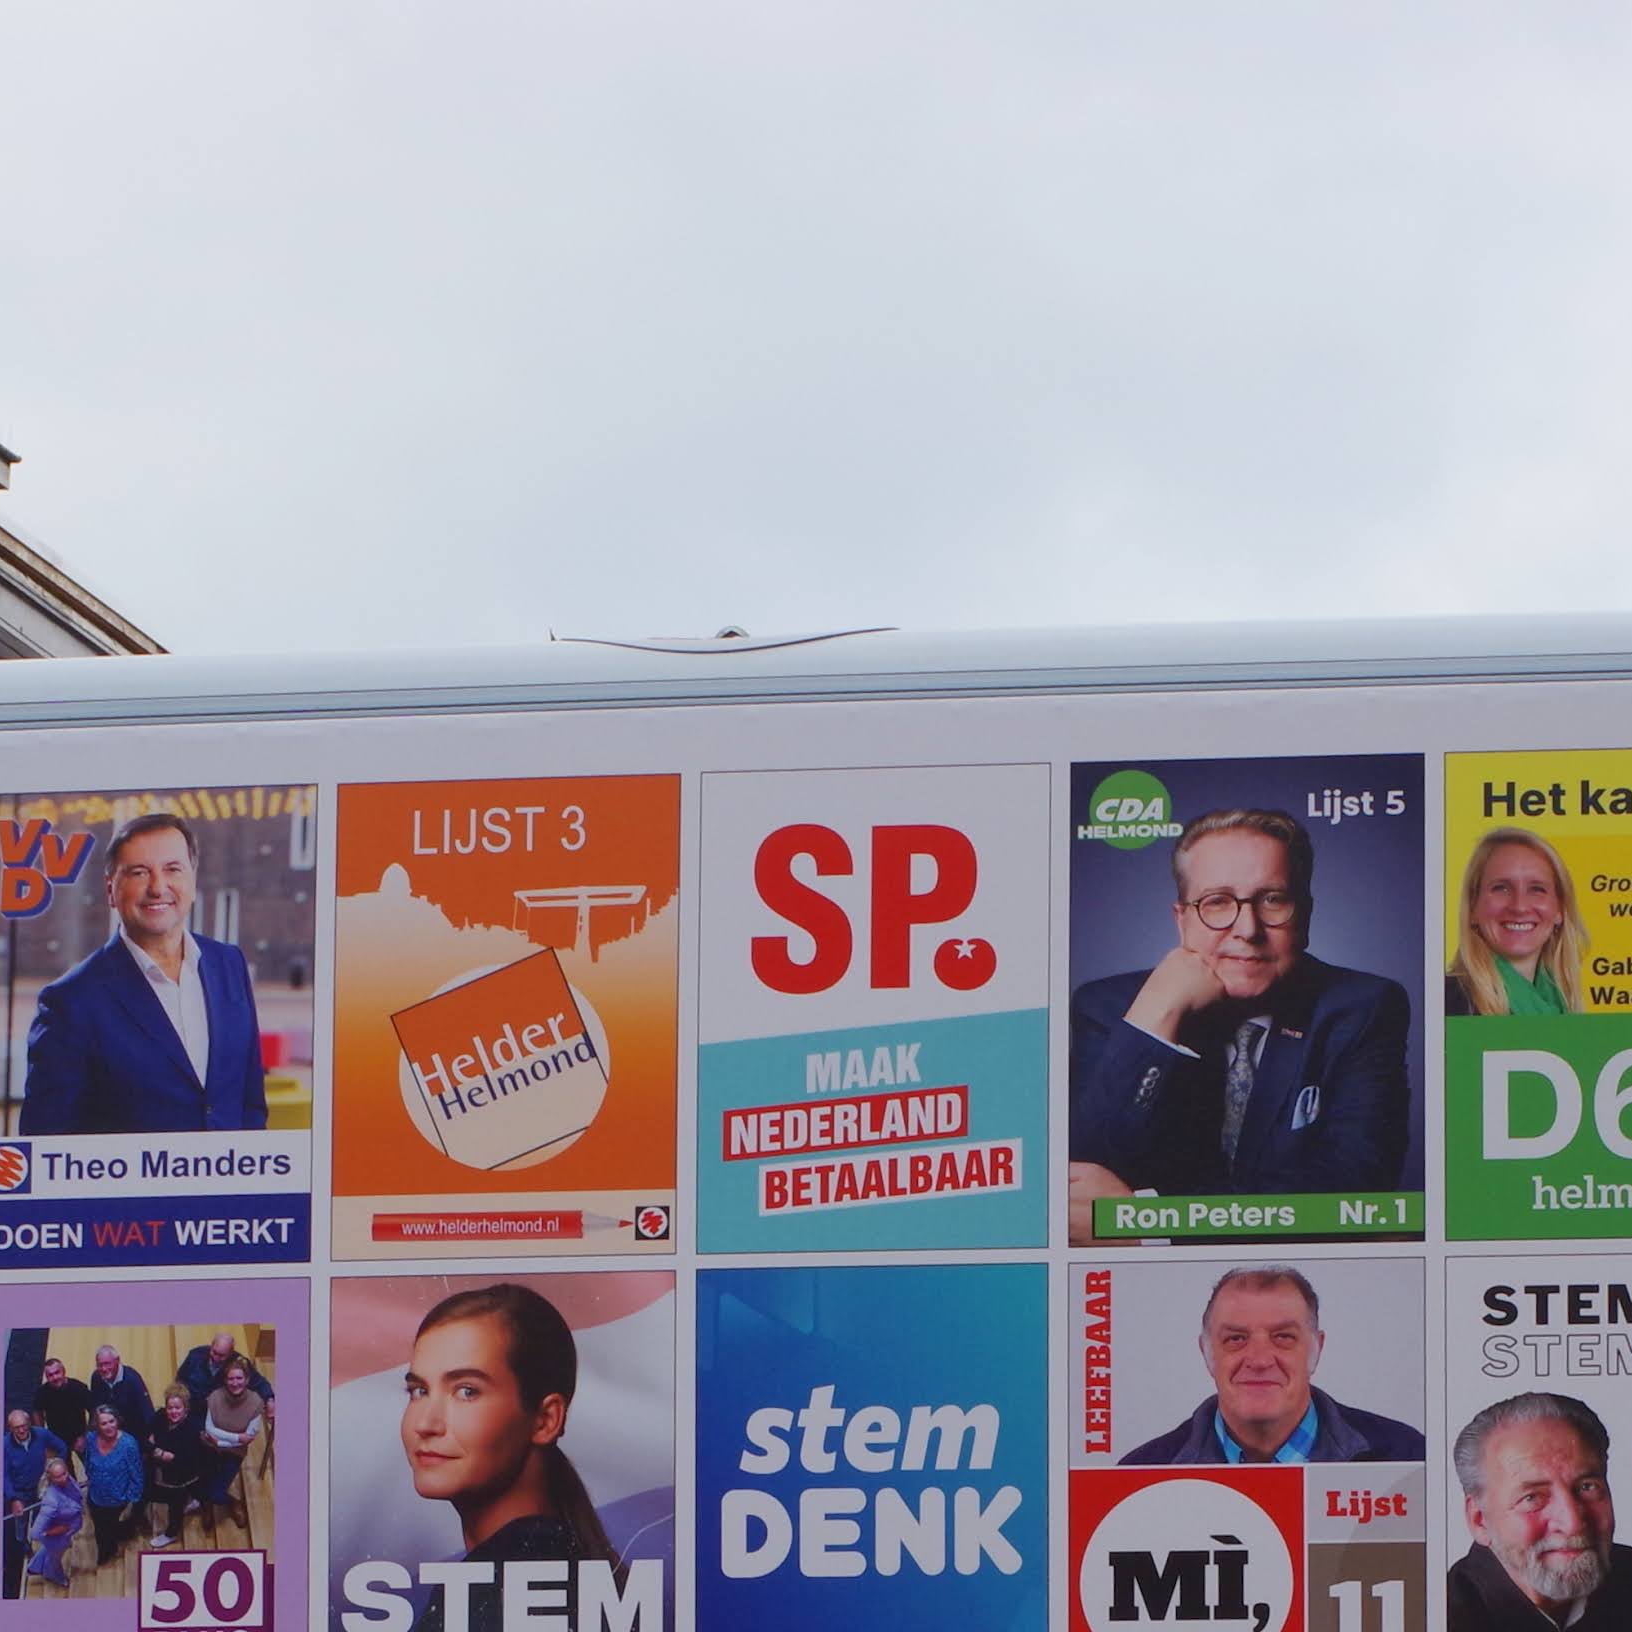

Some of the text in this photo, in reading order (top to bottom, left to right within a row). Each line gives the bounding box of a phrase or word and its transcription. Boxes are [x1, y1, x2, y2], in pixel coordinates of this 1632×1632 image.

[1094, 796, 1165, 822] CDA
[1307, 790, 1406, 825] Lijst 5
[1482, 781, 1565, 817] Het
[412, 805, 588, 855] LIJST 3
[1077, 823, 1183, 840] HELMOND
[410, 1012, 569, 1099] Helder
[436, 1033, 598, 1121] Helmond
[805, 1043, 920, 1094] MAAK
[729, 1091, 963, 1155] NEDERLAND
[40, 1149, 291, 1183] Theo Manders
[765, 1146, 1014, 1210] BETAALBAAR
[94, 1221, 165, 1248] WAT
[175, 1217, 295, 1246] WERKT
[401, 1217, 560, 1237] www.helderhelmond.nl
[1115, 1198, 1407, 1230] Ron Peters Nr. 1
[1085, 1269, 1112, 1454] LEEFBAAR
[739, 1385, 1001, 1475] stem
[1326, 1491, 1407, 1523] Lijst
[720, 1486, 1024, 1579] DENK
[150, 1556, 256, 1623] 50
